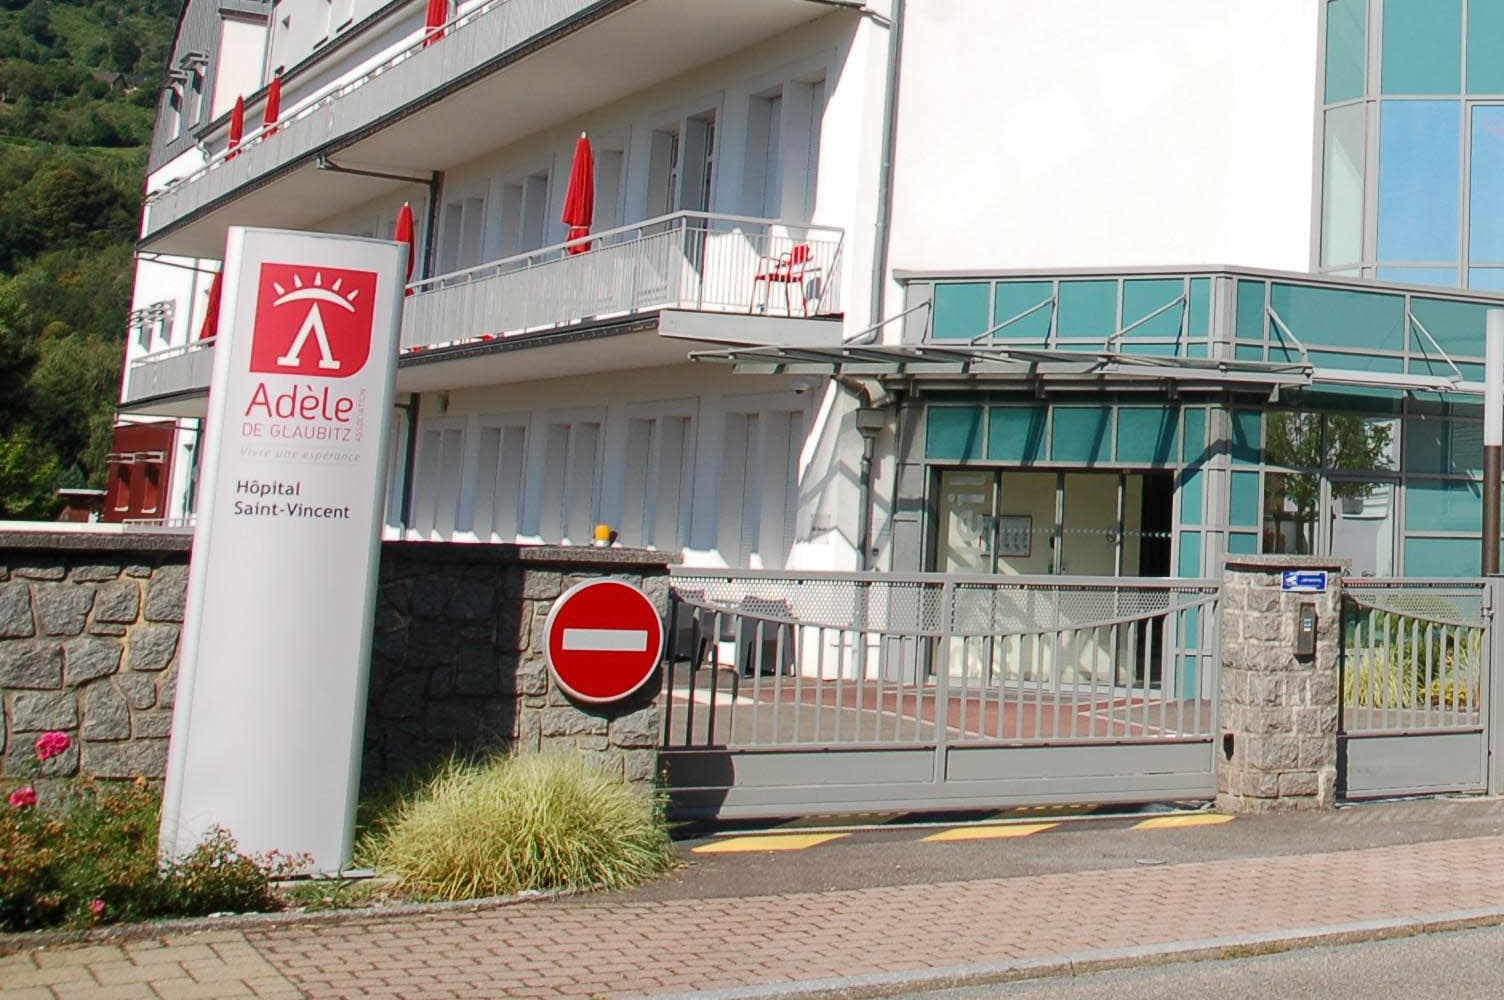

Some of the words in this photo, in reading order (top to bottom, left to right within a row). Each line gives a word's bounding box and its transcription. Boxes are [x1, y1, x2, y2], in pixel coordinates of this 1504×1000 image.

[244, 382, 354, 423] Adèle
[242, 422, 262, 437] DE
[270, 424, 352, 442] GLAUBITZ
[240, 446, 272, 458] Vivre
[276, 449, 298, 459] une
[301, 449, 361, 463] espérance
[236, 480, 301, 498] Hôpital
[234, 501, 351, 519] Saint-Vincent
